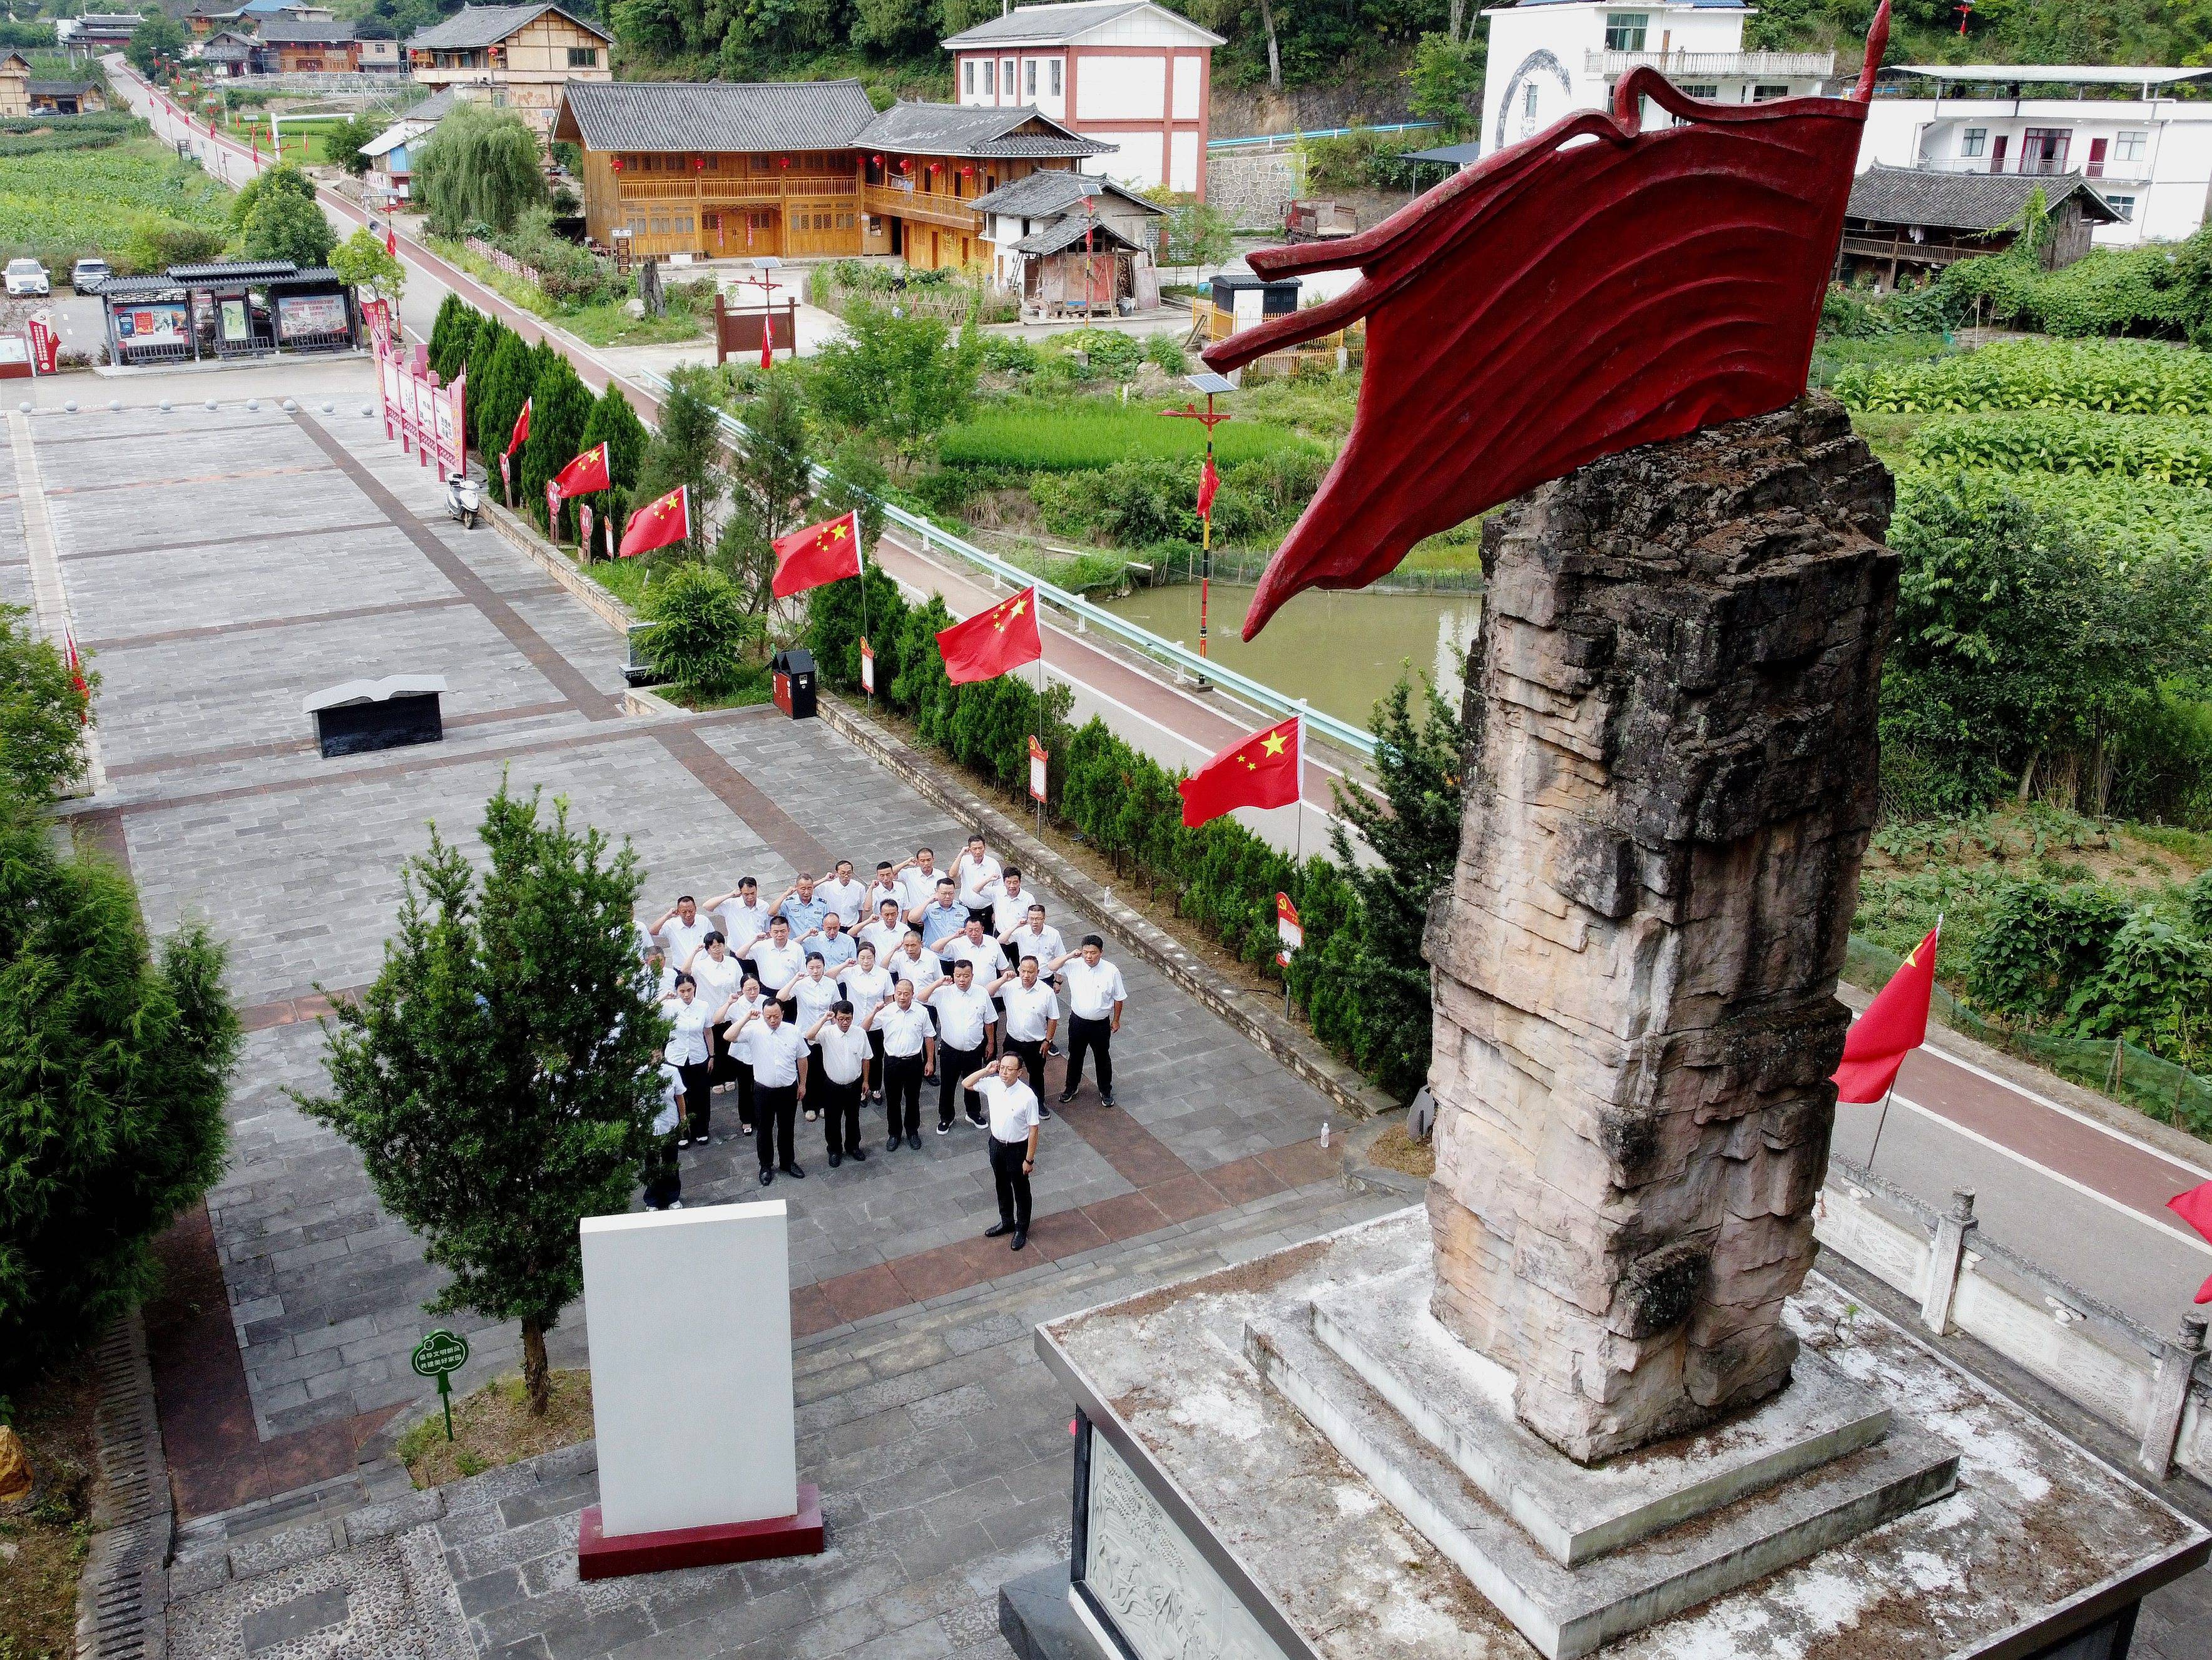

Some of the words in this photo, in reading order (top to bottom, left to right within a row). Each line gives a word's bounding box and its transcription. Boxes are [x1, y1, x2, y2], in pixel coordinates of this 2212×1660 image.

[420, 1354, 461, 1369] 共建美好家园
